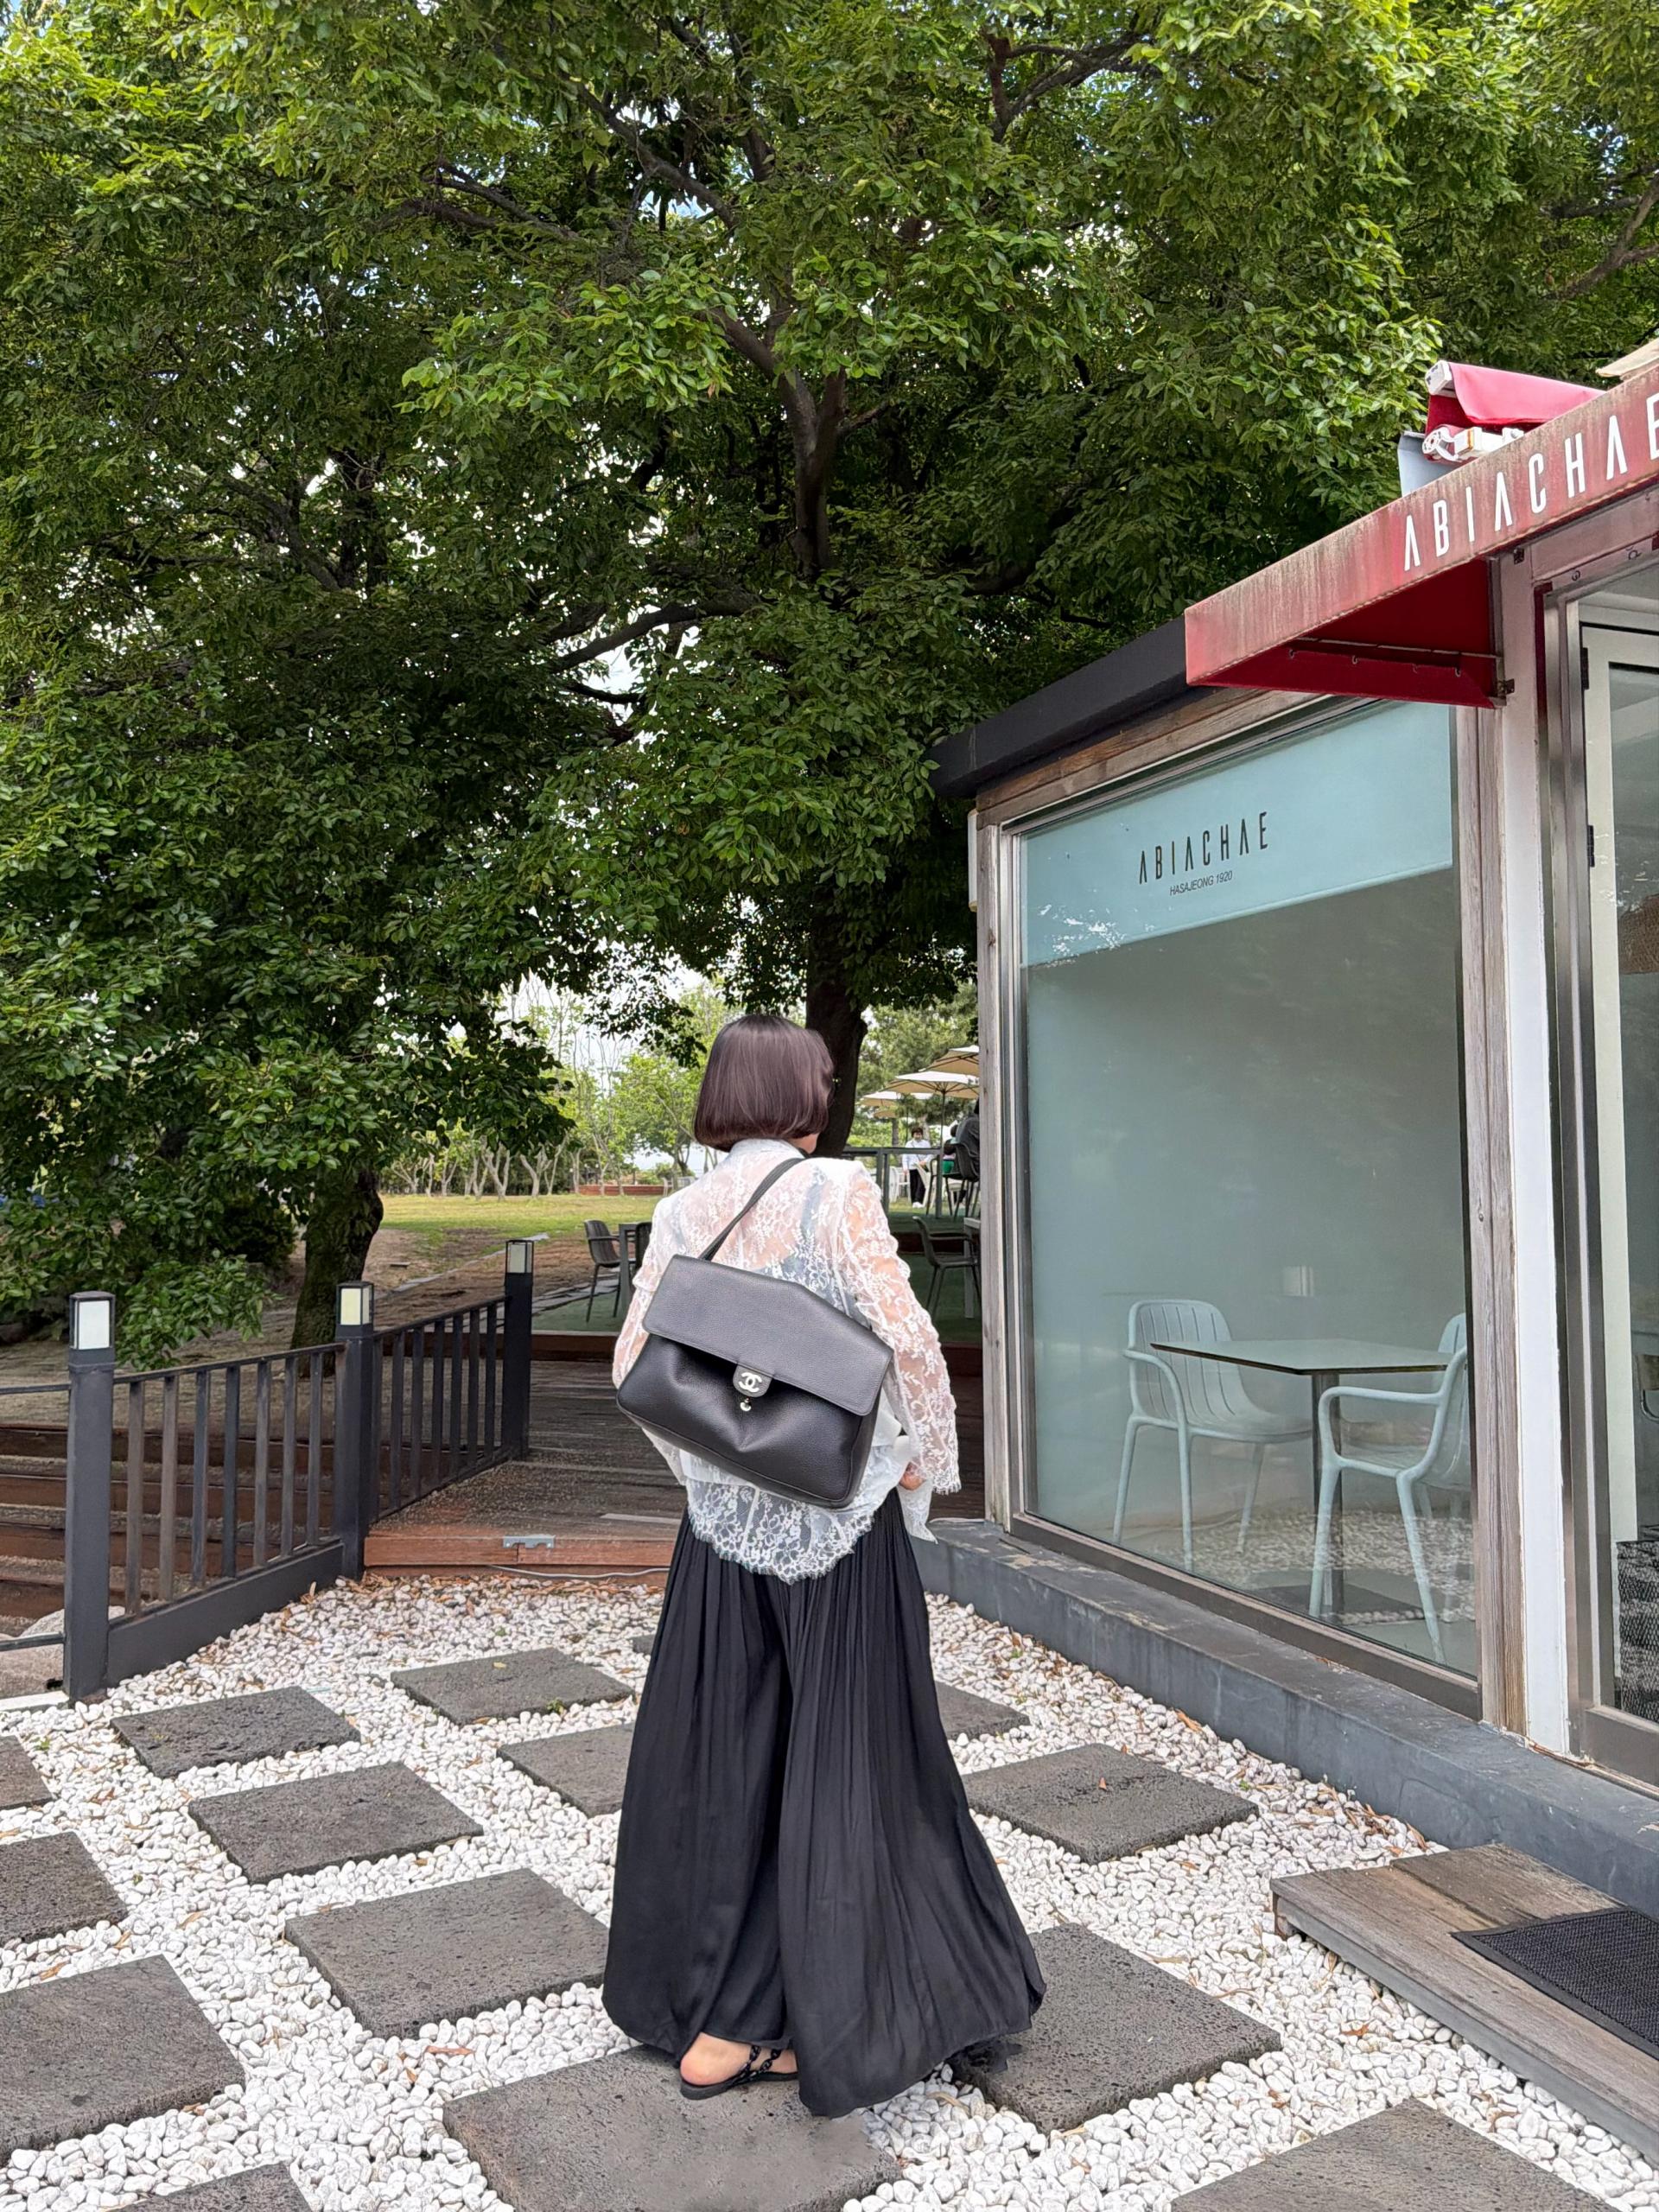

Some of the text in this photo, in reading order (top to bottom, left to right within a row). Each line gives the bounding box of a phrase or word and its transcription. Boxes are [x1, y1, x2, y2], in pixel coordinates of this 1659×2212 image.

[1403, 392, 1659, 572] ABIACHAE
[1139, 811, 1268, 885] ABIACHAE
[1169, 870, 1233, 896] HASAJEONG 1920
